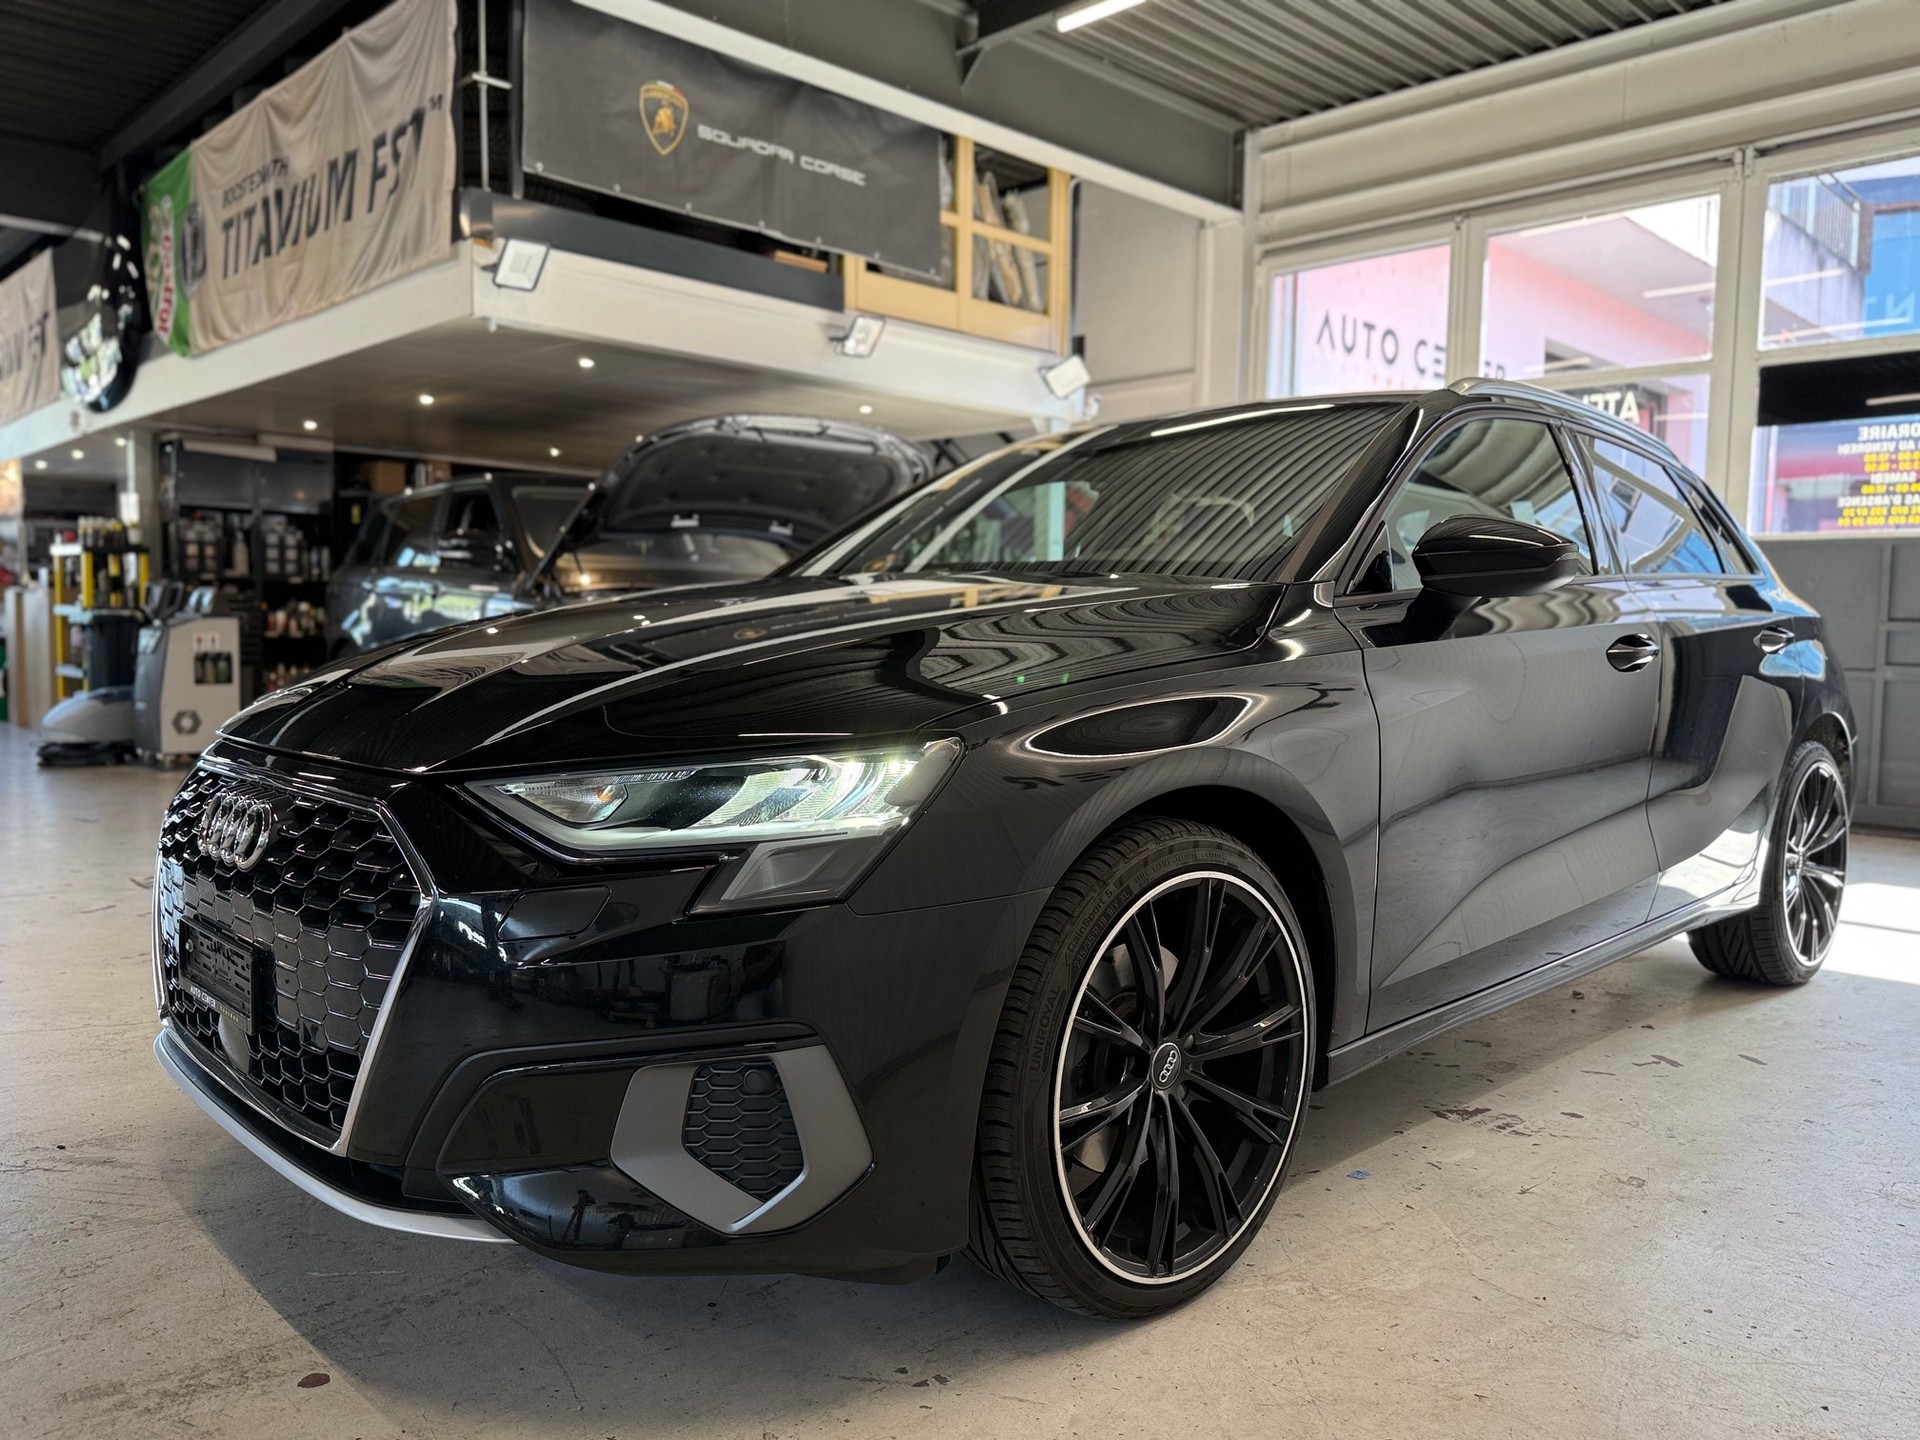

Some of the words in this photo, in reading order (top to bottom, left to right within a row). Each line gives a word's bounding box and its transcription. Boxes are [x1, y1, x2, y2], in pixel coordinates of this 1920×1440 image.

[697, 124, 795, 164] SQUADRA
[800, 154, 867, 187] CORSE
[1316, 308, 1399, 365] AUTO
[1067, 897, 1106, 953] RainSport
[1104, 888, 1113, 898] 5
[1029, 986, 1061, 1072] UNIROYAL
